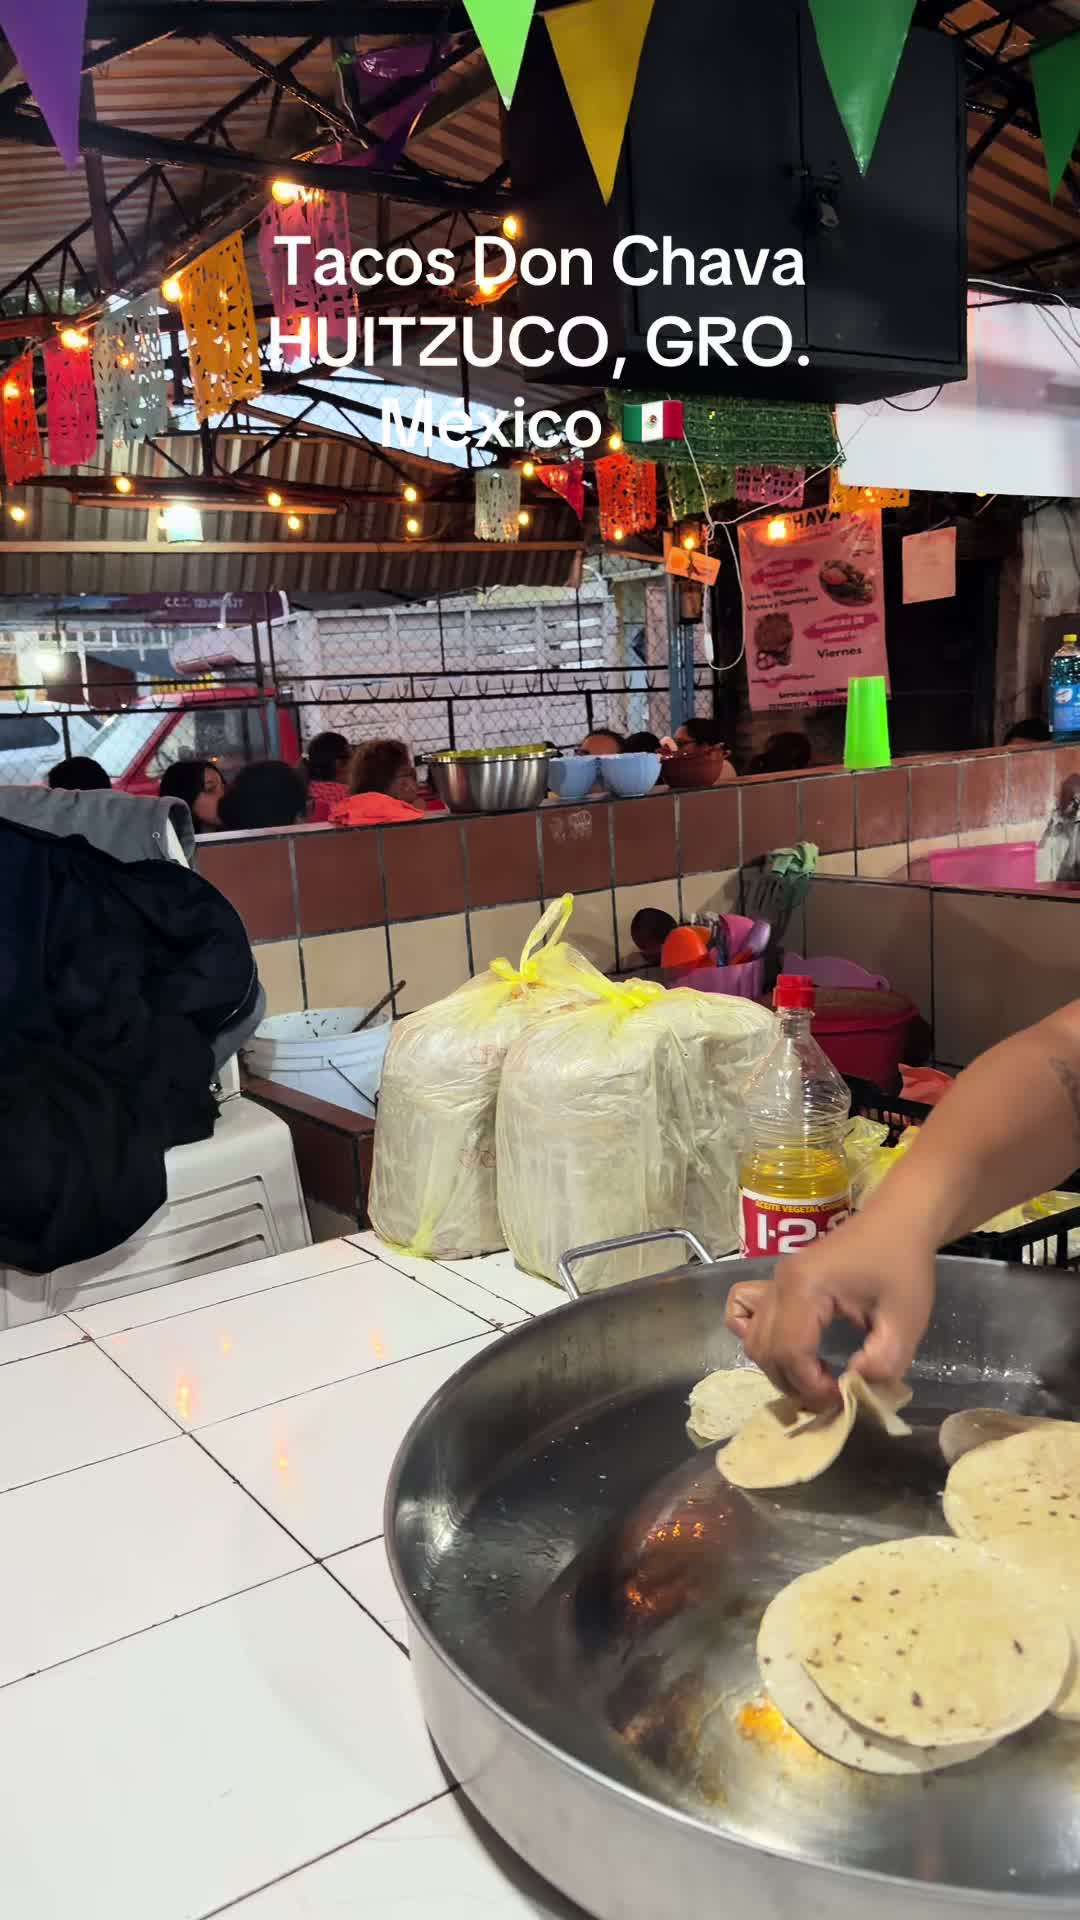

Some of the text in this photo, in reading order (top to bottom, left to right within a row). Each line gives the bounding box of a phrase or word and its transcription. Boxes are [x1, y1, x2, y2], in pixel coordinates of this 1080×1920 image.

[816, 647, 863, 659] Viernes
[755, 1200, 781, 1212] ACEITE
[782, 1205, 820, 1214] VEGETAL
